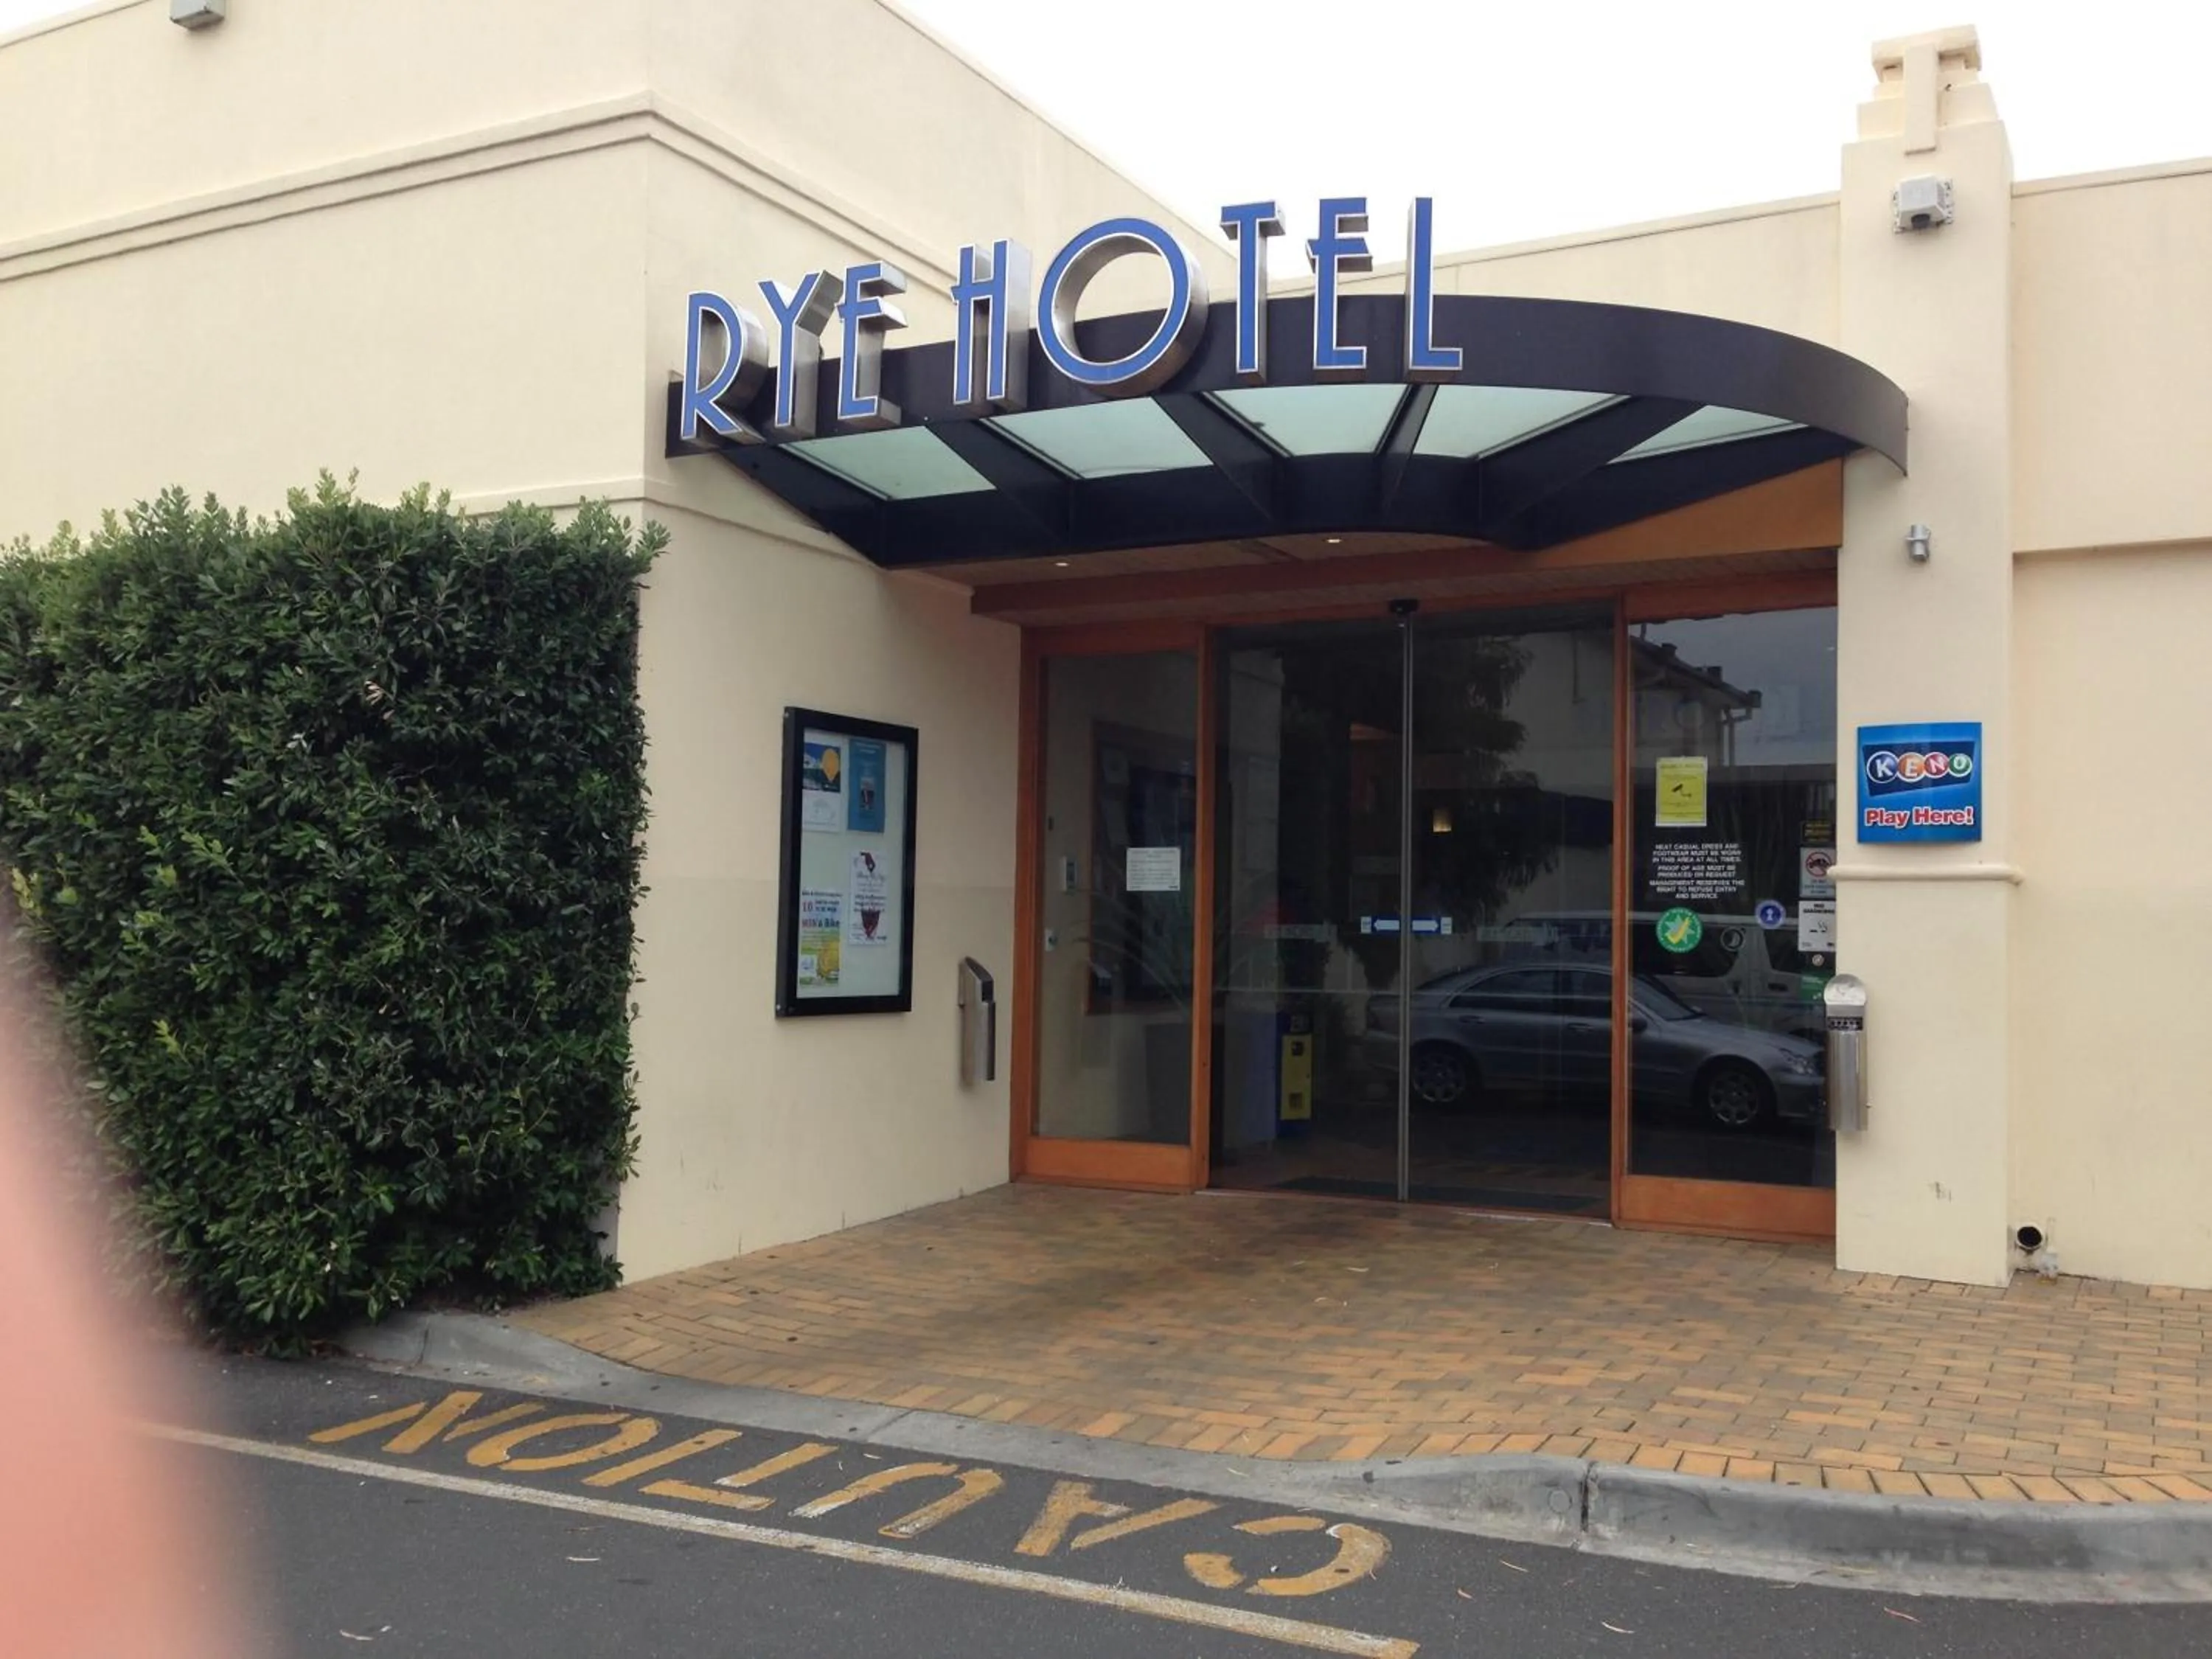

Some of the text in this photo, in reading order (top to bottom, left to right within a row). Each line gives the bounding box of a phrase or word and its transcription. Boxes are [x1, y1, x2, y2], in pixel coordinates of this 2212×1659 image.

[679, 196, 1464, 440] RYE HOTEL
[1865, 806, 1974, 828] Play Here!
[1873, 754, 1969, 779] KENO
[307, 1390, 1393, 1596] CAUTION
